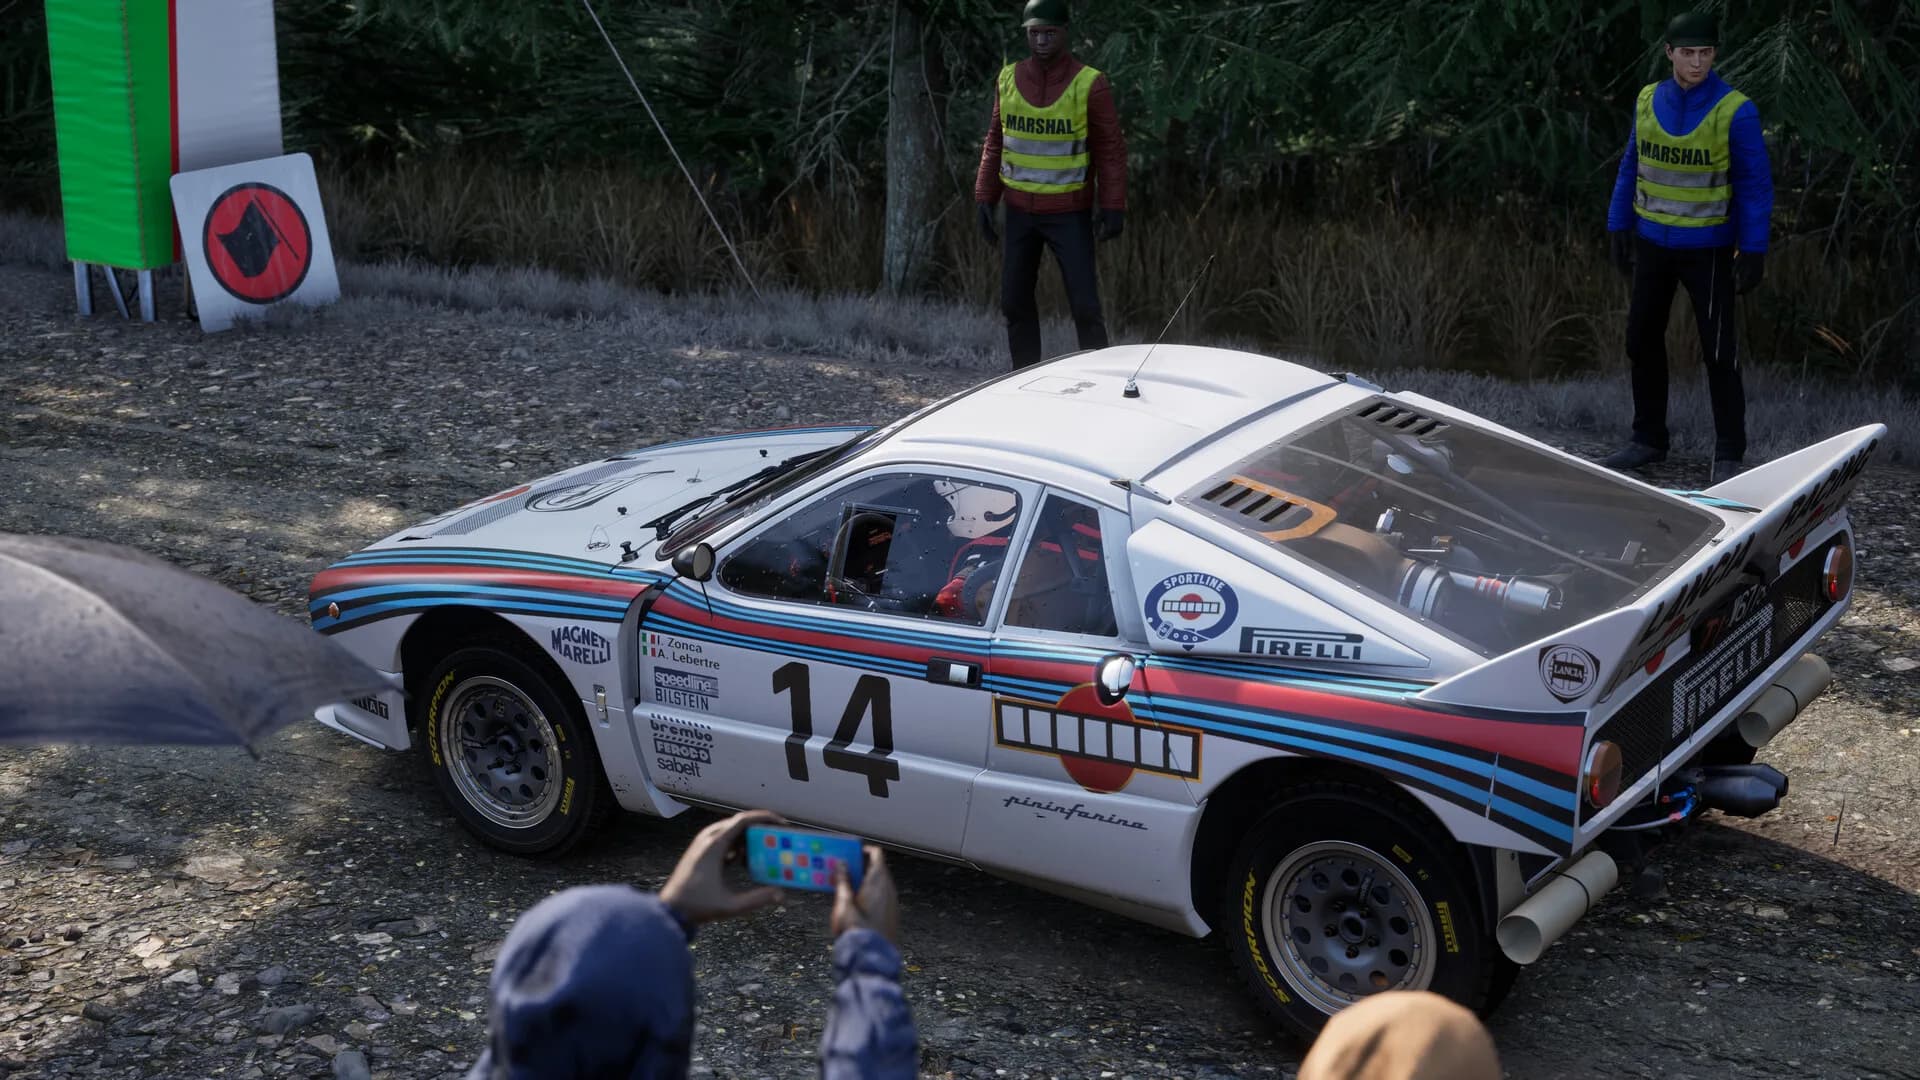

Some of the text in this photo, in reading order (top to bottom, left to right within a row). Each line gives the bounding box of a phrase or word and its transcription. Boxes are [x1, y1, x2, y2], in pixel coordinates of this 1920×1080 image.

[1006, 113, 1074, 135] MARSHAL
[1640, 139, 1713, 166] MARSHAL
[1163, 573, 1225, 592] SPORTLINE
[551, 625, 611, 652] MAGNETI
[668, 637, 702, 654] Zonca
[1239, 626, 1364, 660] PIRELLI
[551, 638, 611, 665] MARELLI
[657, 648, 720, 670] A. Lebertre
[655, 671, 711, 692] speedline
[1672, 602, 1774, 740] PIRELLI
[656, 688, 709, 711] BILSTEIN
[650, 720, 713, 742] brembo
[772, 661, 900, 798] 14
[658, 757, 702, 778] sabelt
[1003, 796, 1148, 831] pininfarina
